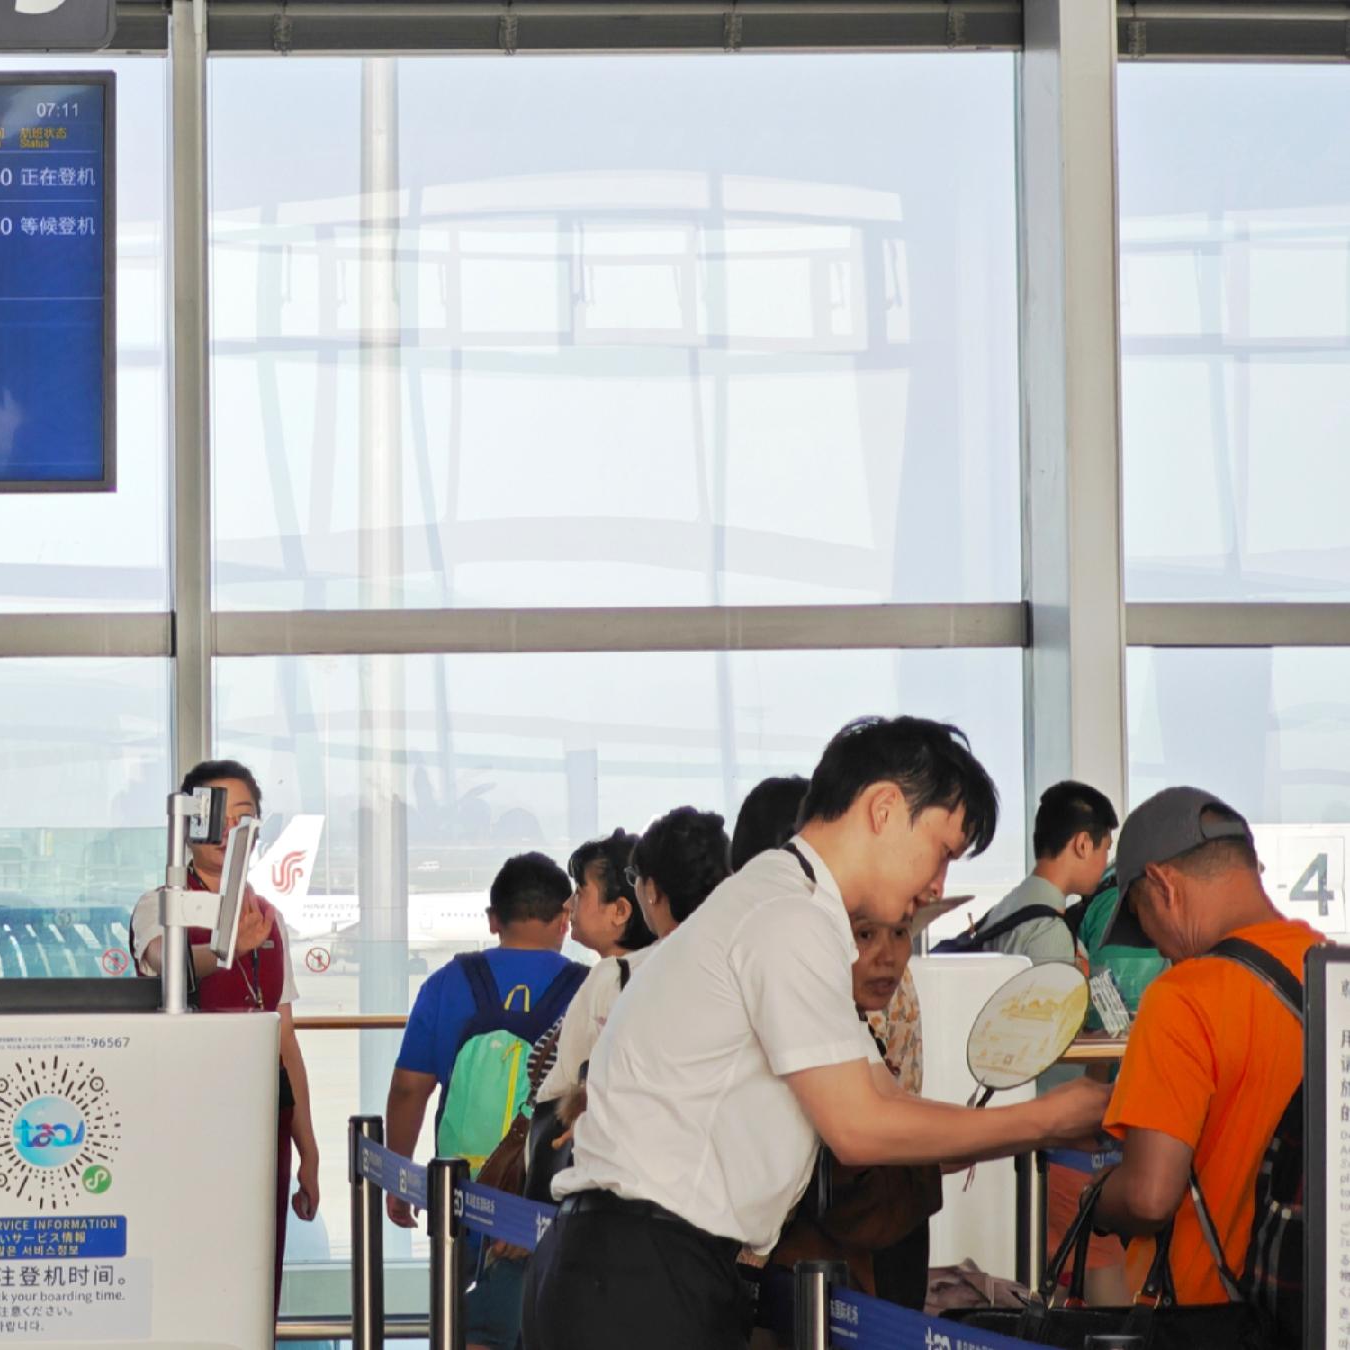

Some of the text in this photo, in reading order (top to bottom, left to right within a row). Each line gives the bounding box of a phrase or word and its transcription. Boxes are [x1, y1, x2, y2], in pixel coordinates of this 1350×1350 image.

[36, 102, 79, 118] 07:11
[19, 139, 49, 149] Status
[20, 167, 96, 187] 正在登机
[20, 216, 96, 236] 等候登机
[34, 1218, 117, 1229] INFORMATION
[11, 1292, 38, 1305] your
[40, 1290, 93, 1304] boarding
[96, 1289, 126, 1300] time.
